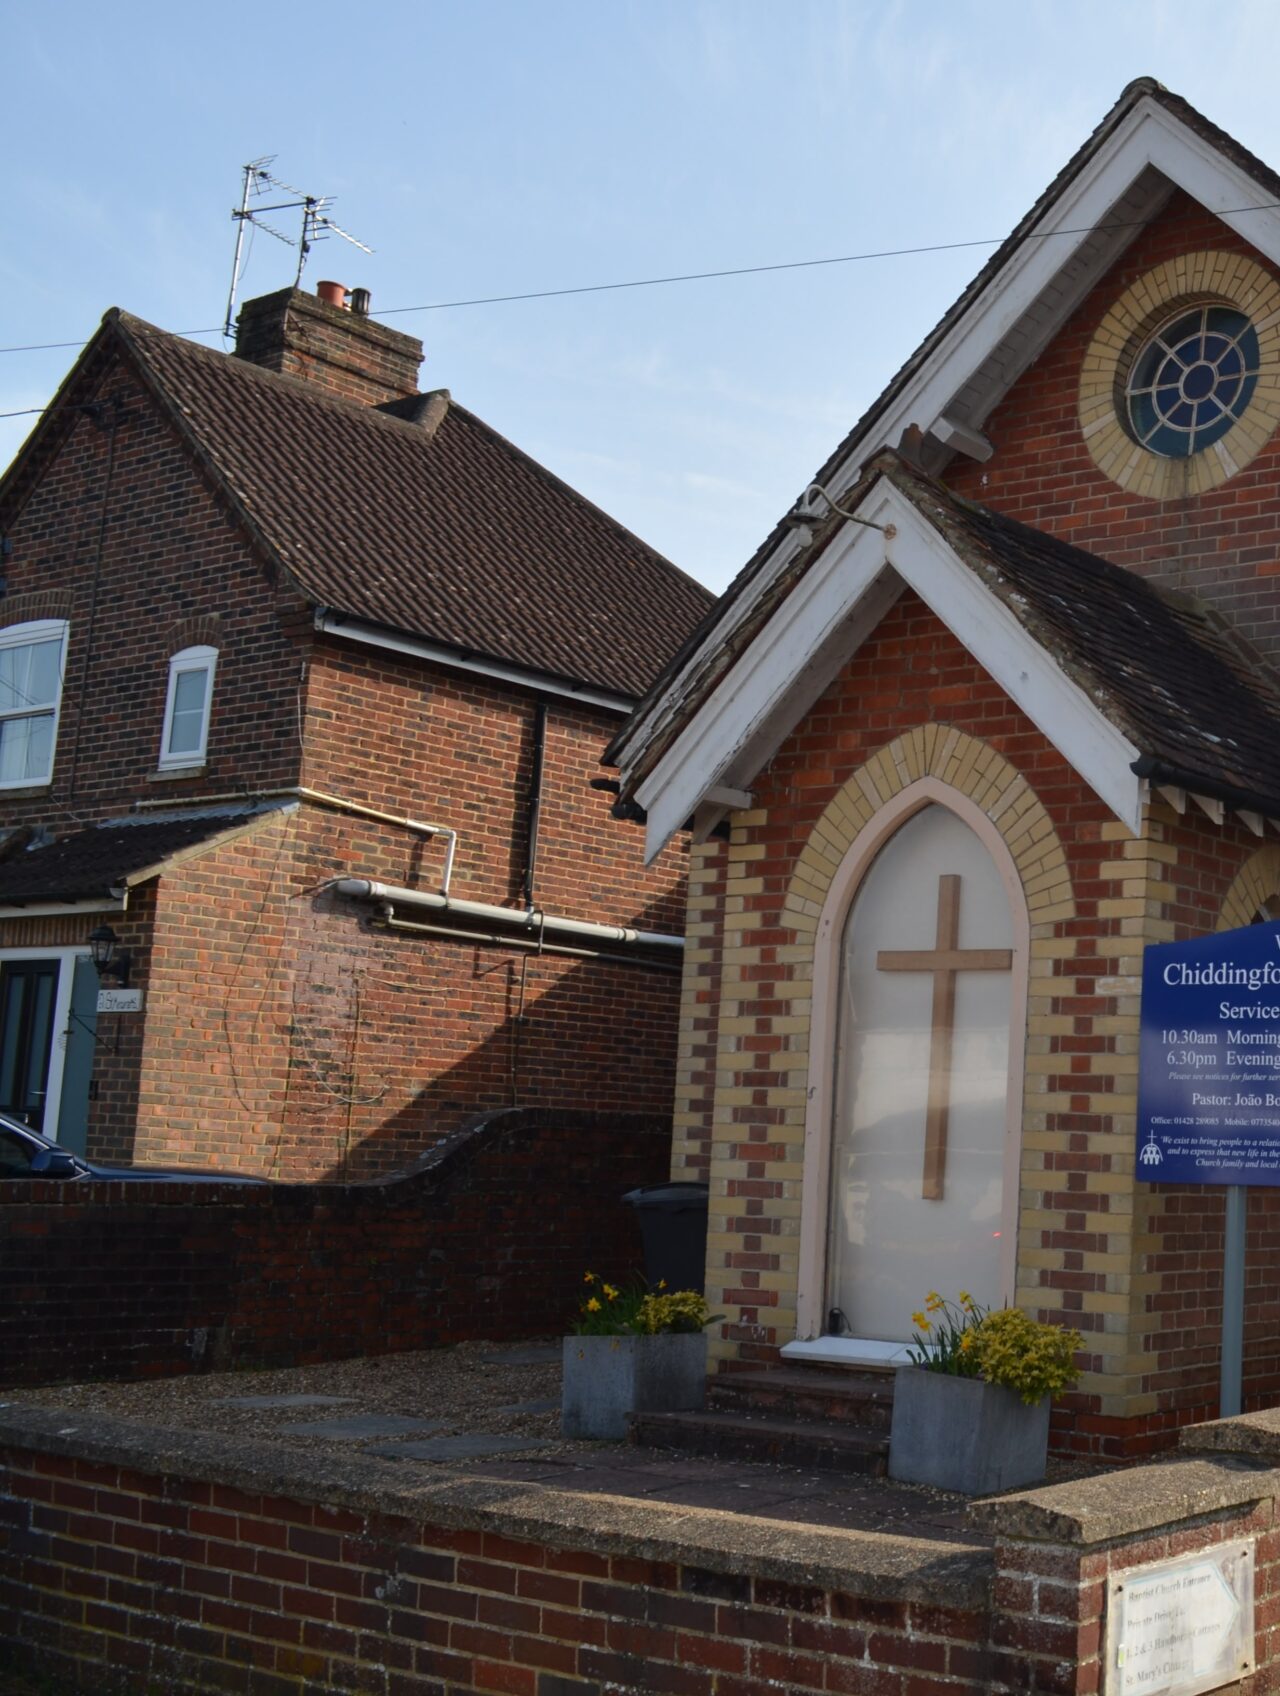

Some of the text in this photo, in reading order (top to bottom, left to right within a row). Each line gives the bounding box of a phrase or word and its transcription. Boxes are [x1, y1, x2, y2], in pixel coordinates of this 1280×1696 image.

[1161, 1030, 1218, 1045] 10.30am
[1166, 1051, 1217, 1068] 6.30pm
[1168, 1072, 1191, 1081] Please
[1192, 1073, 1203, 1081] see
[1204, 1072, 1229, 1082] notices
[1229, 1072, 1241, 1083] for
[1241, 1072, 1268, 1083] further
[1192, 1092, 1232, 1106] Pastor:
[1151, 1116, 1174, 1125] Office:
[1224, 1118, 1250, 1127] Mobile:
[1174, 1136, 1190, 1145] exist
[1199, 1136, 1218, 1147] bring
[1218, 1137, 1242, 1148] people
[1167, 1147, 1181, 1155] and
[1190, 1148, 1215, 1158] express
[1217, 1148, 1232, 1156] that
[1232, 1149, 1246, 1157] new
[1247, 1148, 1259, 1159] life
[1260, 1149, 1268, 1158] in
[1269, 1149, 1280, 1158] the
[1195, 1158, 1221, 1168] Church
[1220, 1159, 1244, 1170] family
[1245, 1159, 1259, 1168] and
[1260, 1160, 1279, 1169] local
